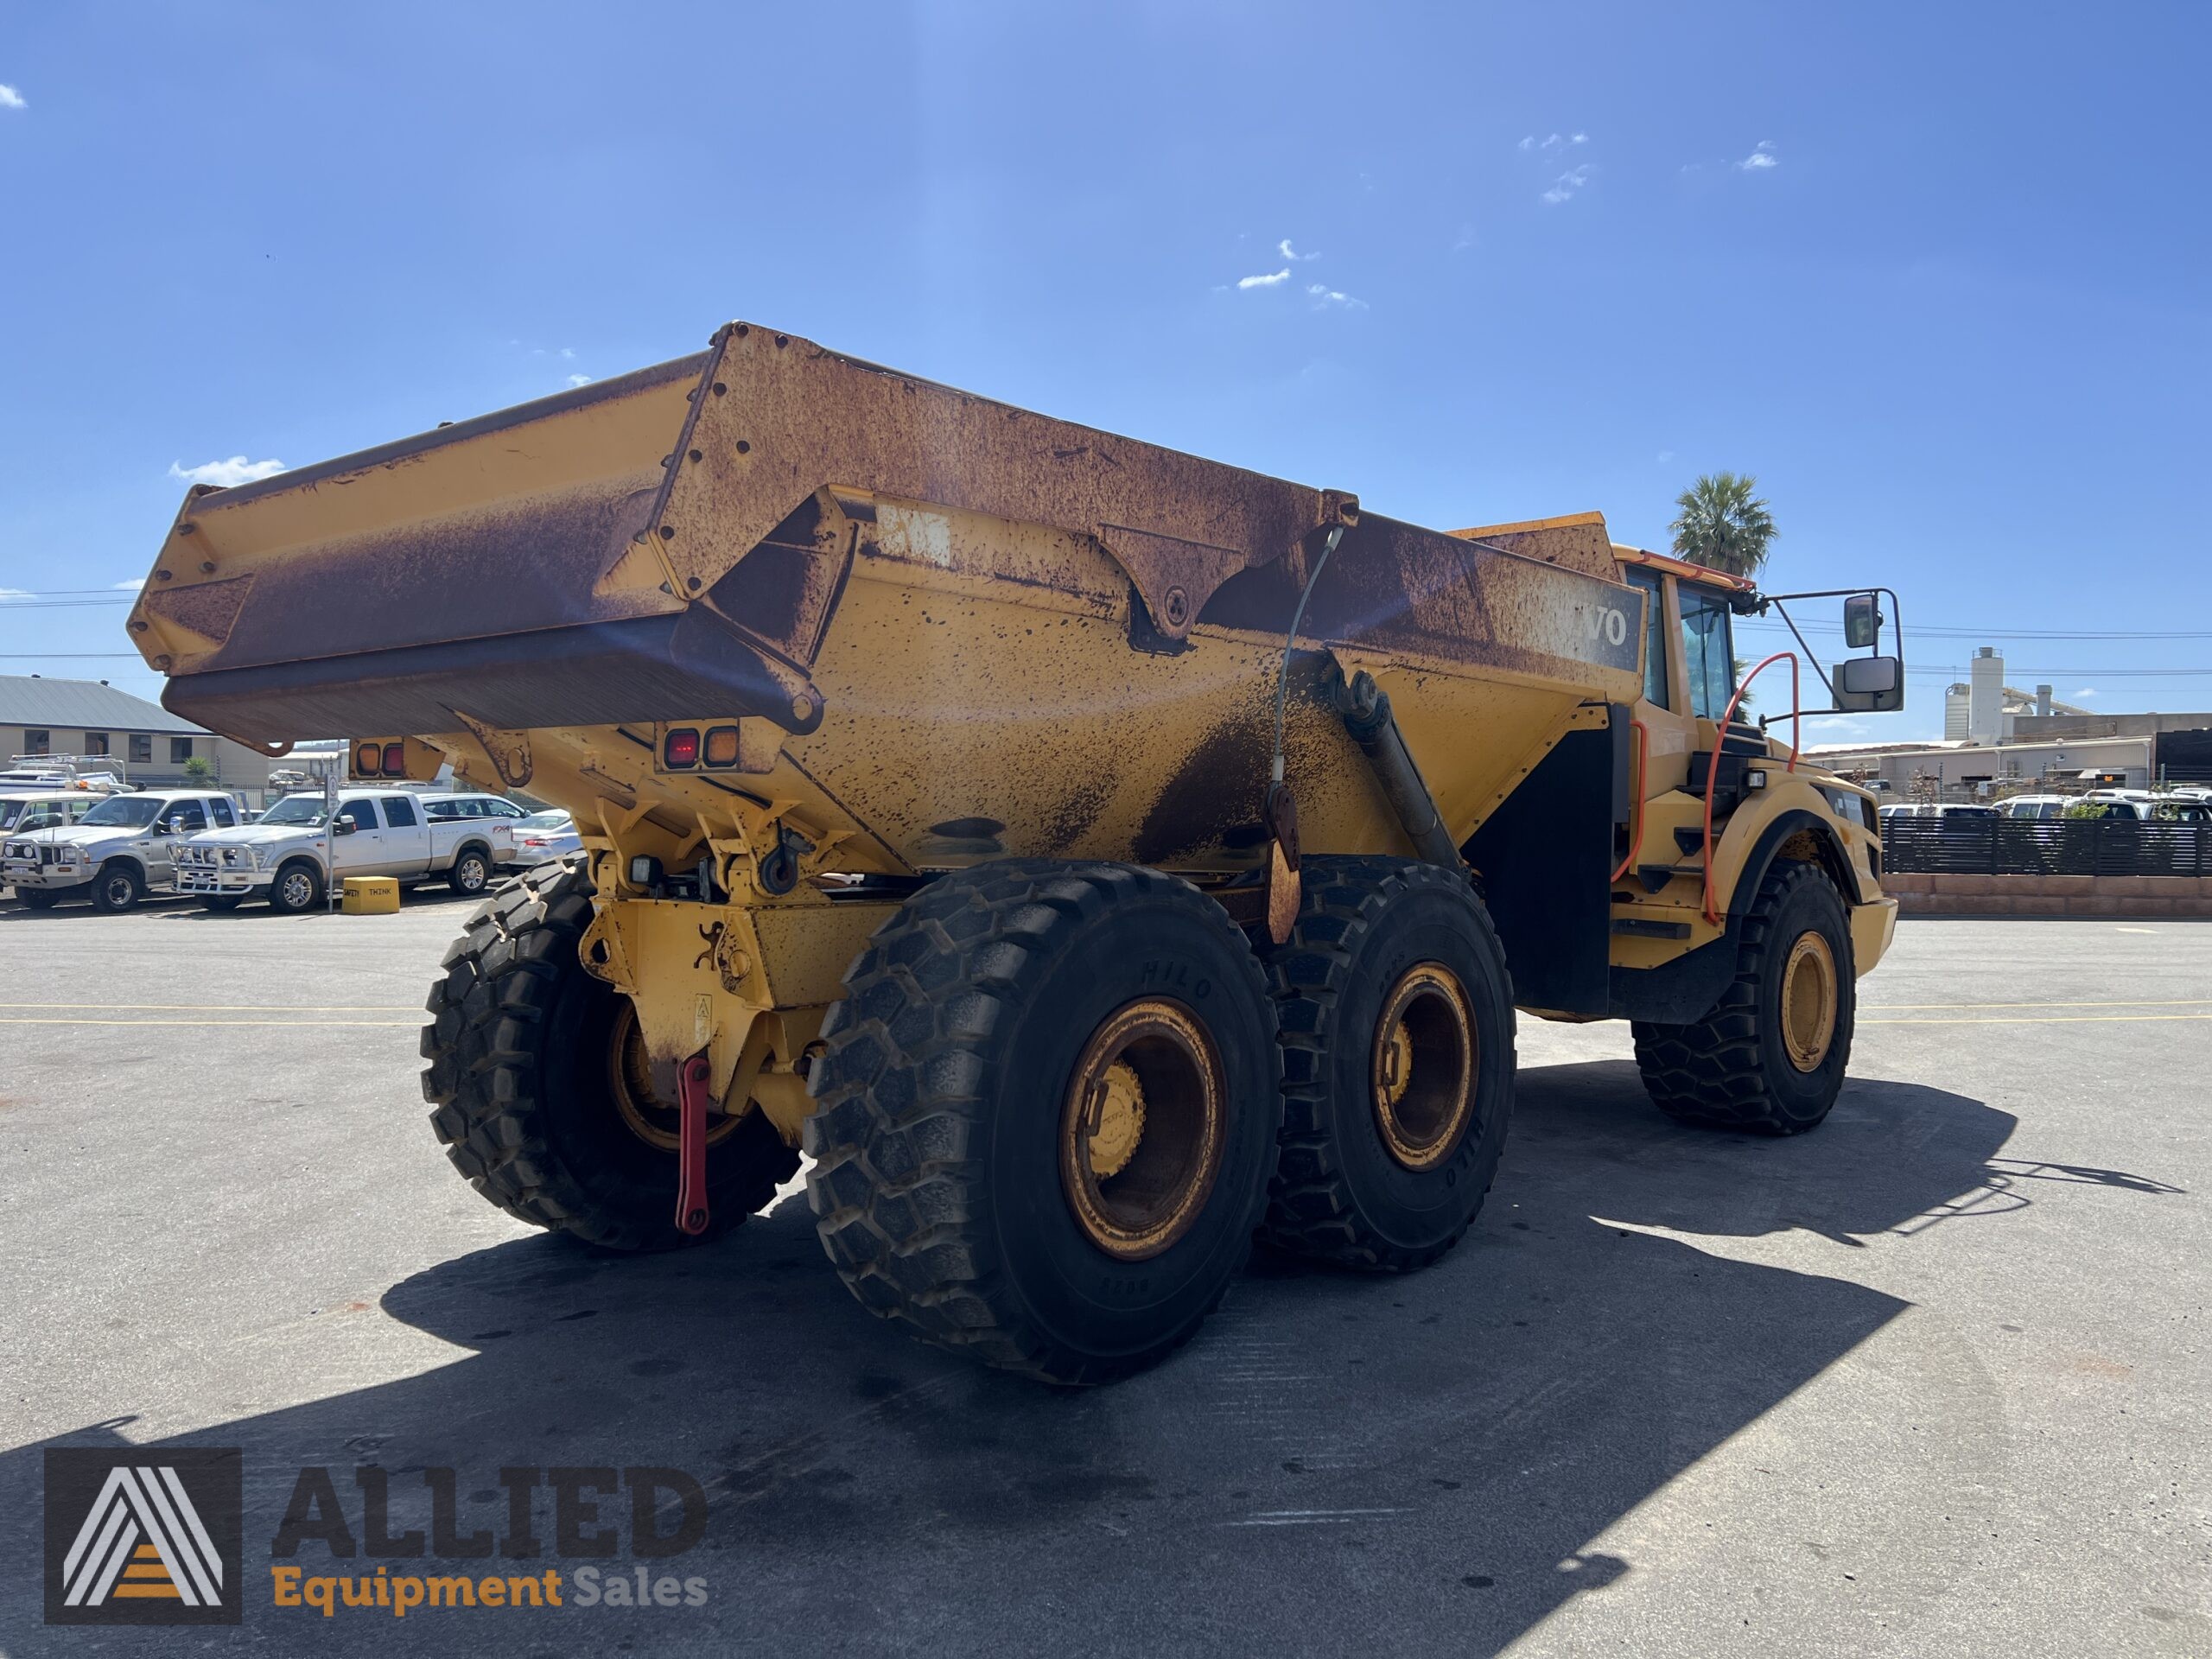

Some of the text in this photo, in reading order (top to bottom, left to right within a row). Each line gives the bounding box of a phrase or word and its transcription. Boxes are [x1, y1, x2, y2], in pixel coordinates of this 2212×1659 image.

[343, 888, 359, 898] SAFETY
[368, 887, 392, 896] THINK
[1141, 958, 1211, 1000] HILO
[1446, 1116, 1484, 1188] HILO
